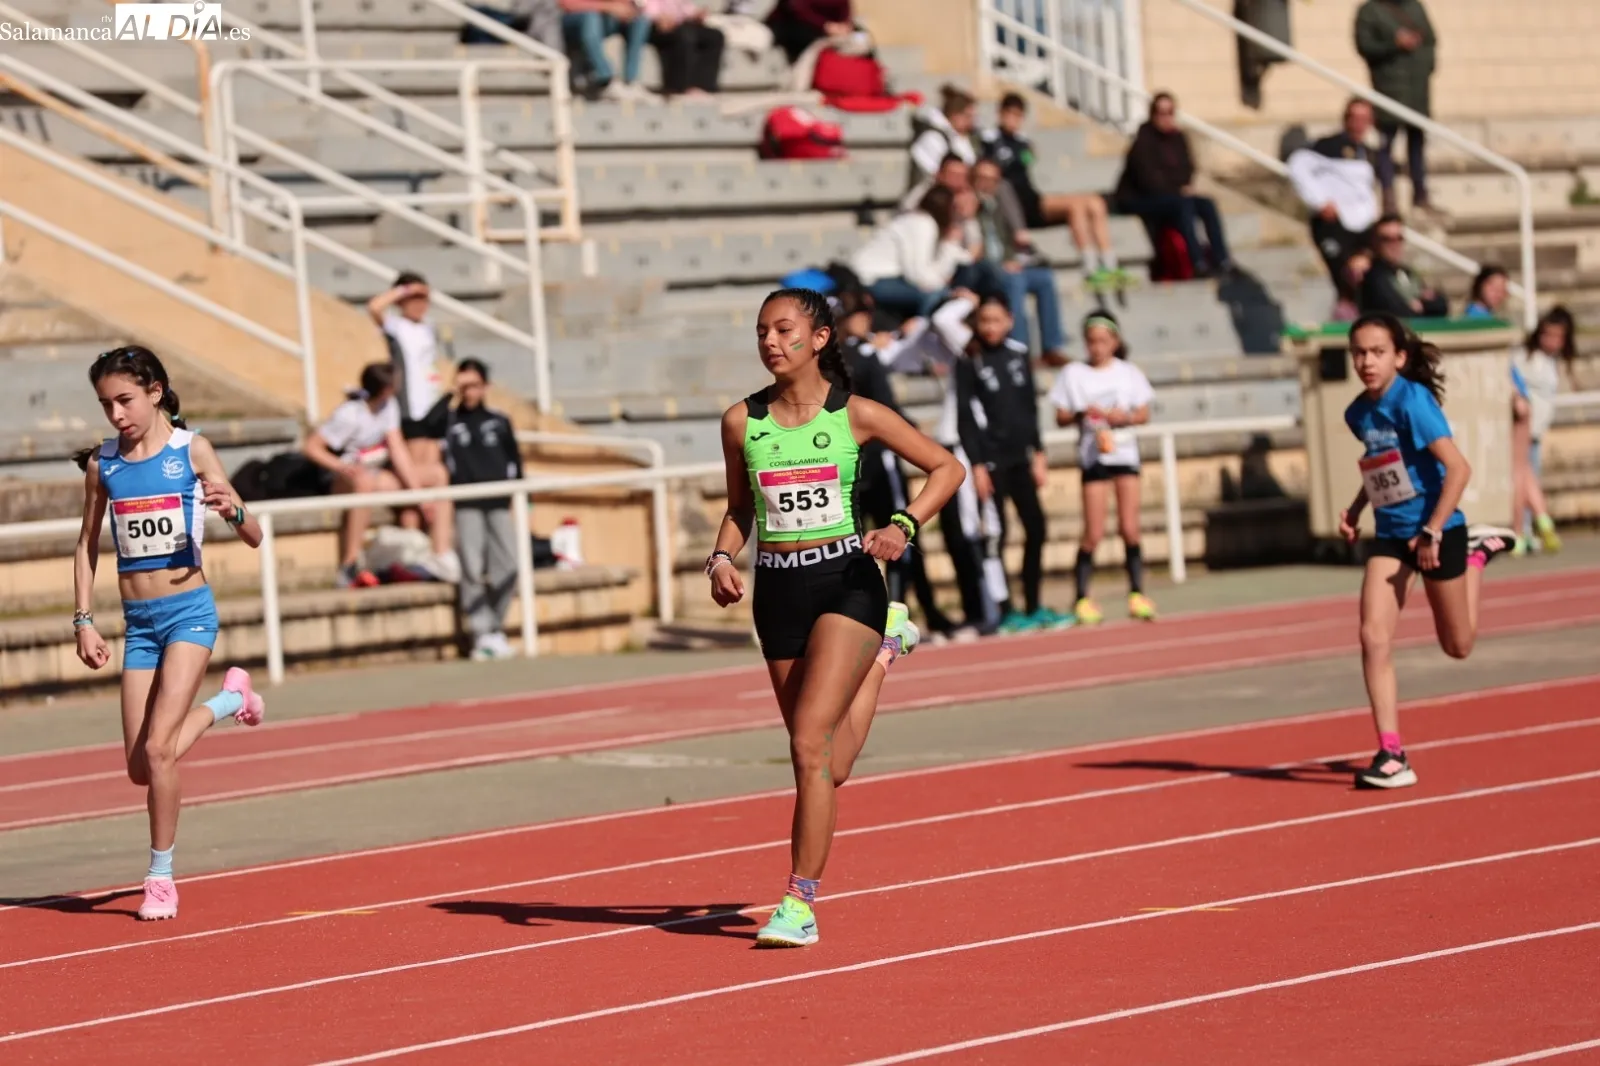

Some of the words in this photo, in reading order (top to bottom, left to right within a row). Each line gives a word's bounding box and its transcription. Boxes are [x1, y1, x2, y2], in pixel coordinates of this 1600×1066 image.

[1369, 469, 1400, 492] 363
[778, 487, 830, 513] 553
[127, 516, 173, 539] 500
